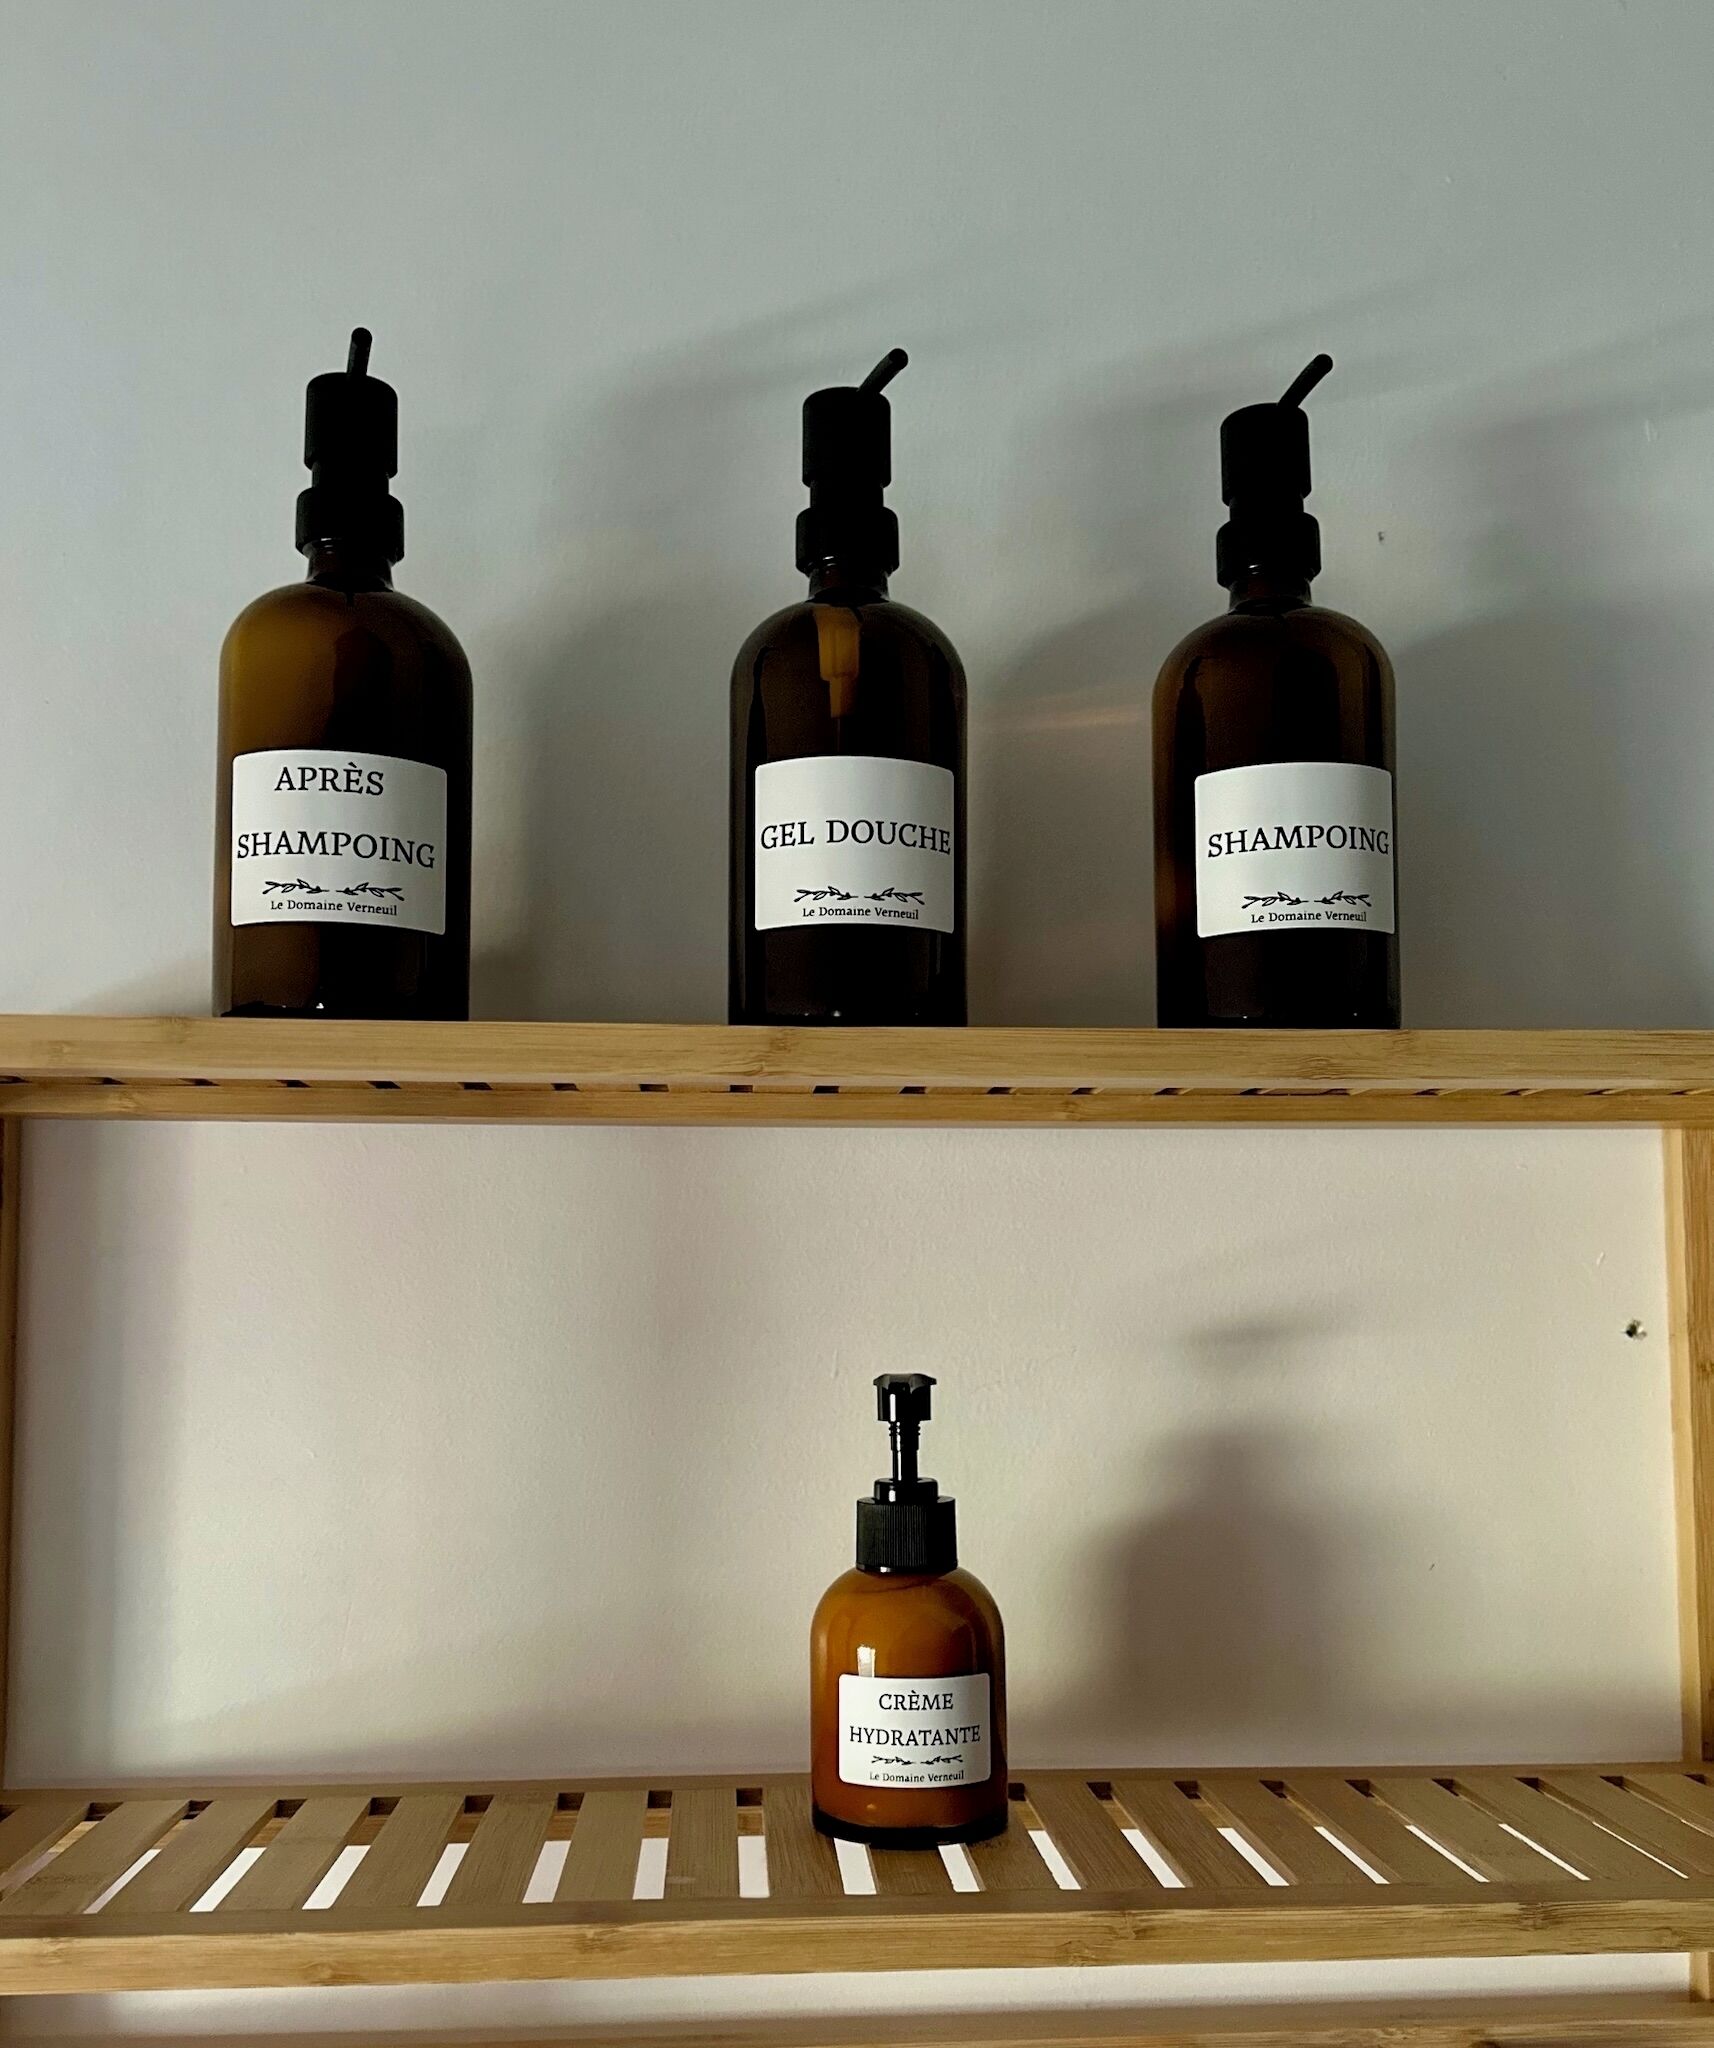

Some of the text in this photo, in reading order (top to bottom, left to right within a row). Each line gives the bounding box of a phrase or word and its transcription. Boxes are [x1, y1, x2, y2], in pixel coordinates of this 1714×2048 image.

[274, 761, 384, 796] APRÈS
[760, 819, 951, 855] GEL DOUCHE
[1207, 825, 1389, 858] SHAMPOING
[236, 830, 435, 869] SHAMPOING
[270, 900, 397, 916] Le Domaine Verneuil
[802, 907, 919, 920] Le Domaine Verneuil
[1251, 911, 1367, 924] Le Domaine Verneuil
[878, 1689, 954, 1711] CRÈME
[849, 1725, 981, 1747] HYDRATANTE
[869, 1770, 965, 1783] Le Domaine Verneuil
